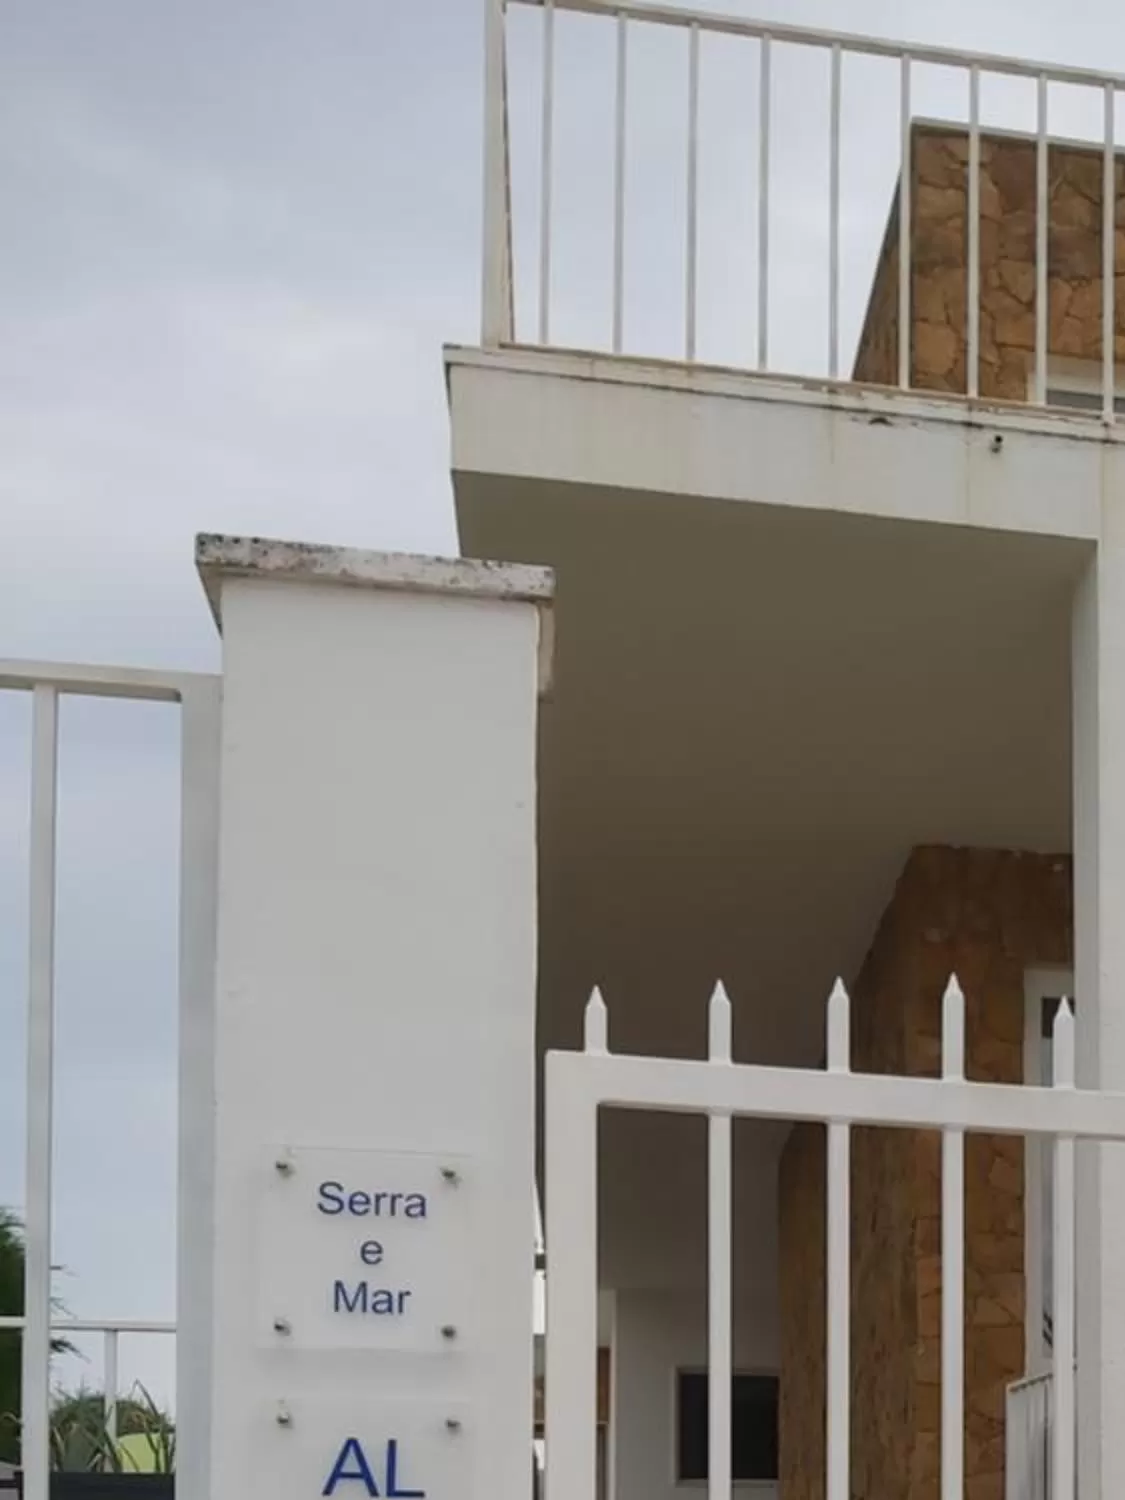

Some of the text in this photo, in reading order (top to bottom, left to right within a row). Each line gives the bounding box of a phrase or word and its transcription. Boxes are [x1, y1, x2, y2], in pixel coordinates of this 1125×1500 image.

[317, 1181, 427, 1218] Serra
[360, 1240, 384, 1265] e
[333, 1280, 412, 1315] Mar
[321, 1437, 426, 1499] AL
